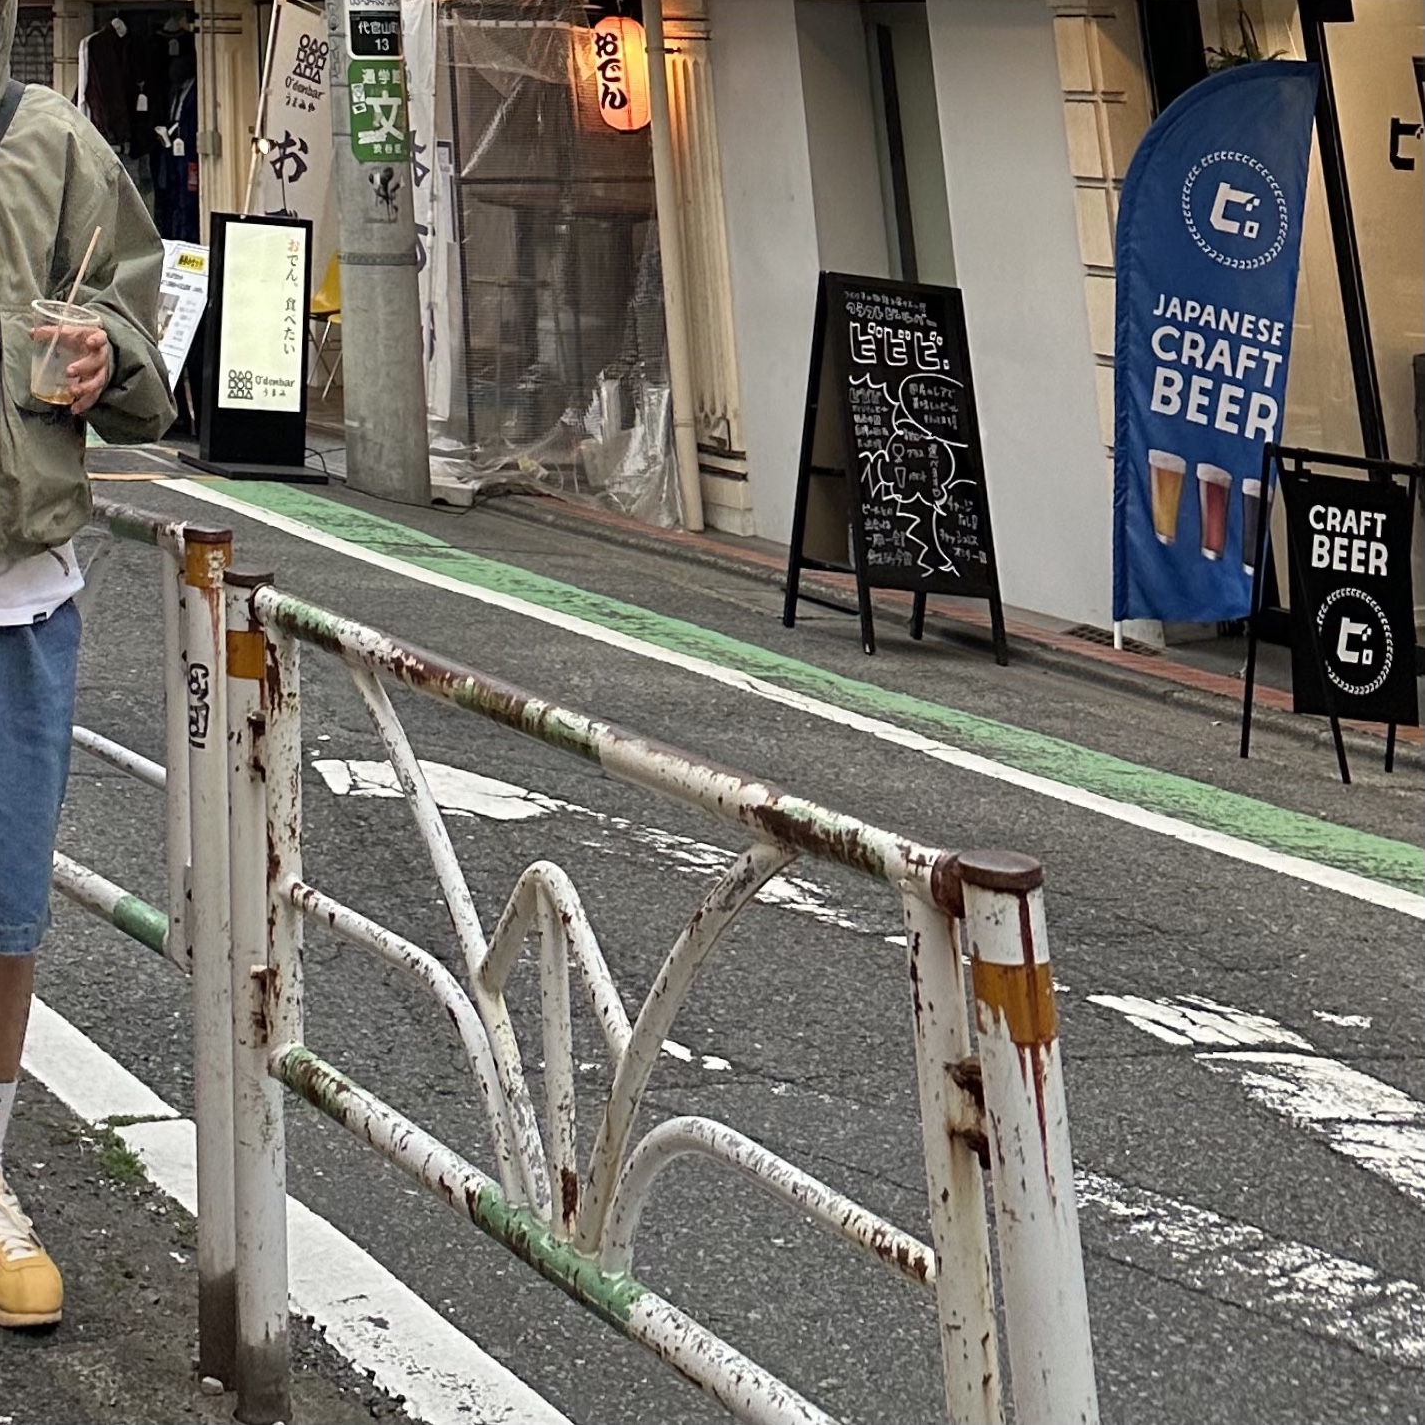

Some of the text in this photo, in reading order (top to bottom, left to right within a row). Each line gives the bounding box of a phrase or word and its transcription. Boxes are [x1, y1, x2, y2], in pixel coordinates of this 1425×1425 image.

[375, 38, 389, 51] 13
[595, 32, 627, 110] おでん
[365, 90, 405, 141] 文
[1153, 293, 1284, 346] JAPANESE
[1151, 325, 1283, 388] CRAFT
[1150, 366, 1279, 443] BEER
[1309, 504, 1387, 538] CRAFT
[1311, 534, 1389, 577] BEER
